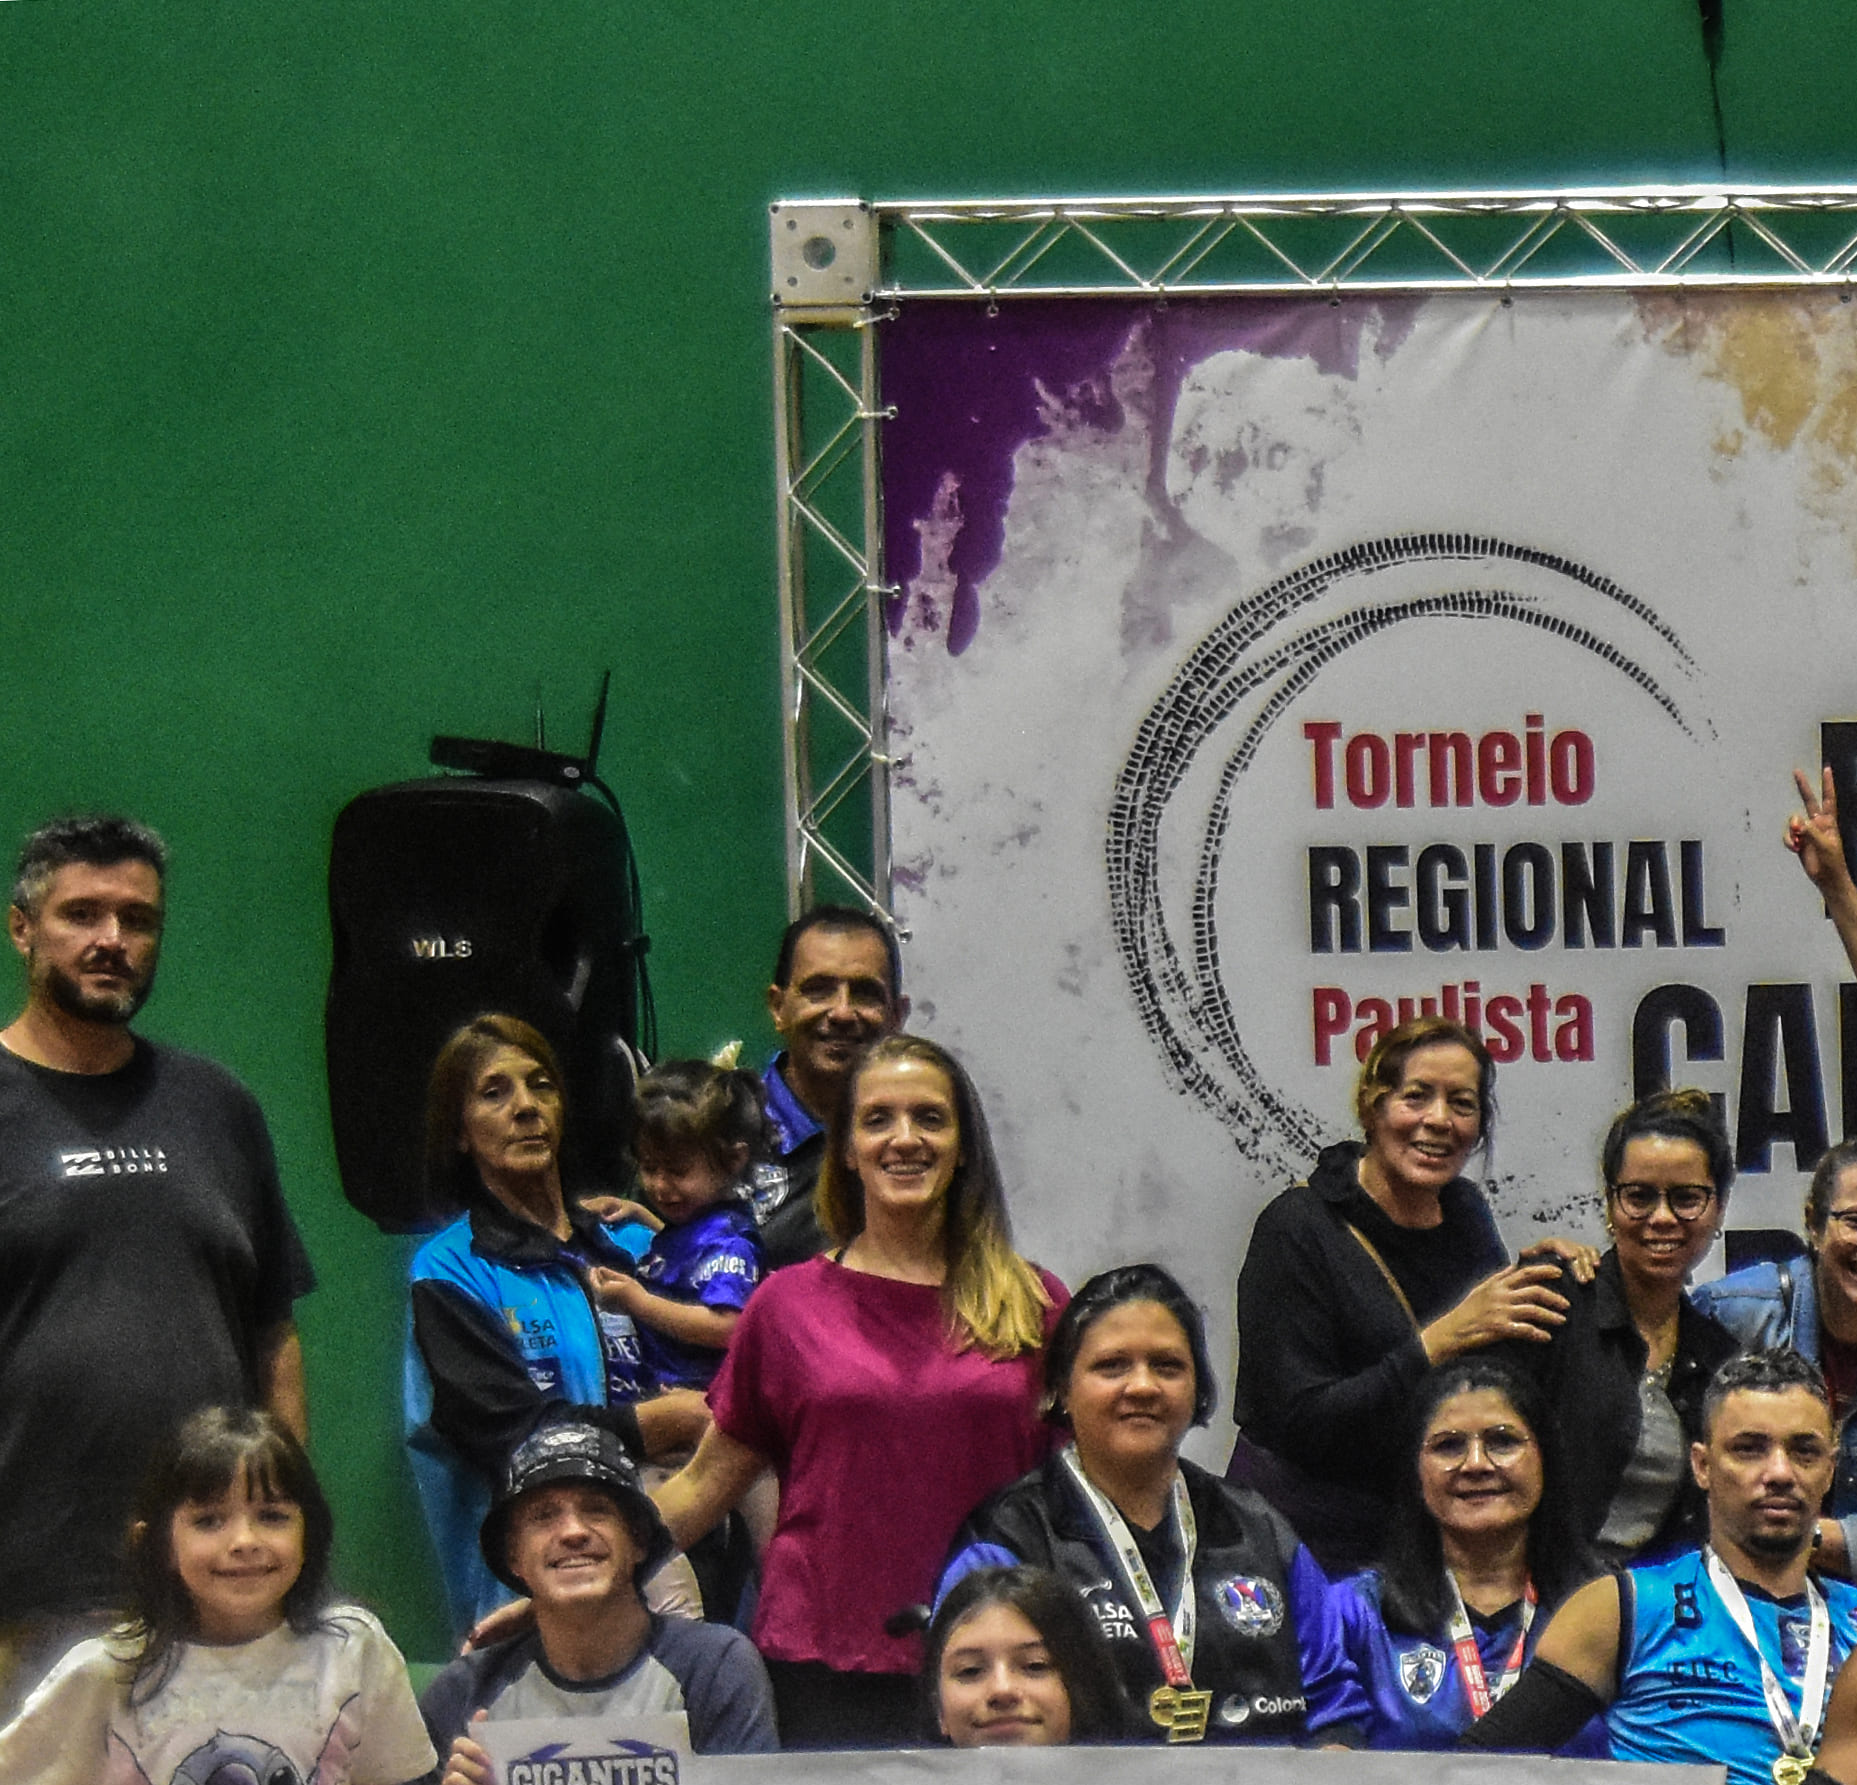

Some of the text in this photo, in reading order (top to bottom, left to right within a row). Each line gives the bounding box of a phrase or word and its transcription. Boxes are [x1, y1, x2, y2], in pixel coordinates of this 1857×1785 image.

[1304, 714, 1596, 810] Torneio
[1308, 840, 1726, 954] REGIONAL
[412, 936, 473, 958] WLS
